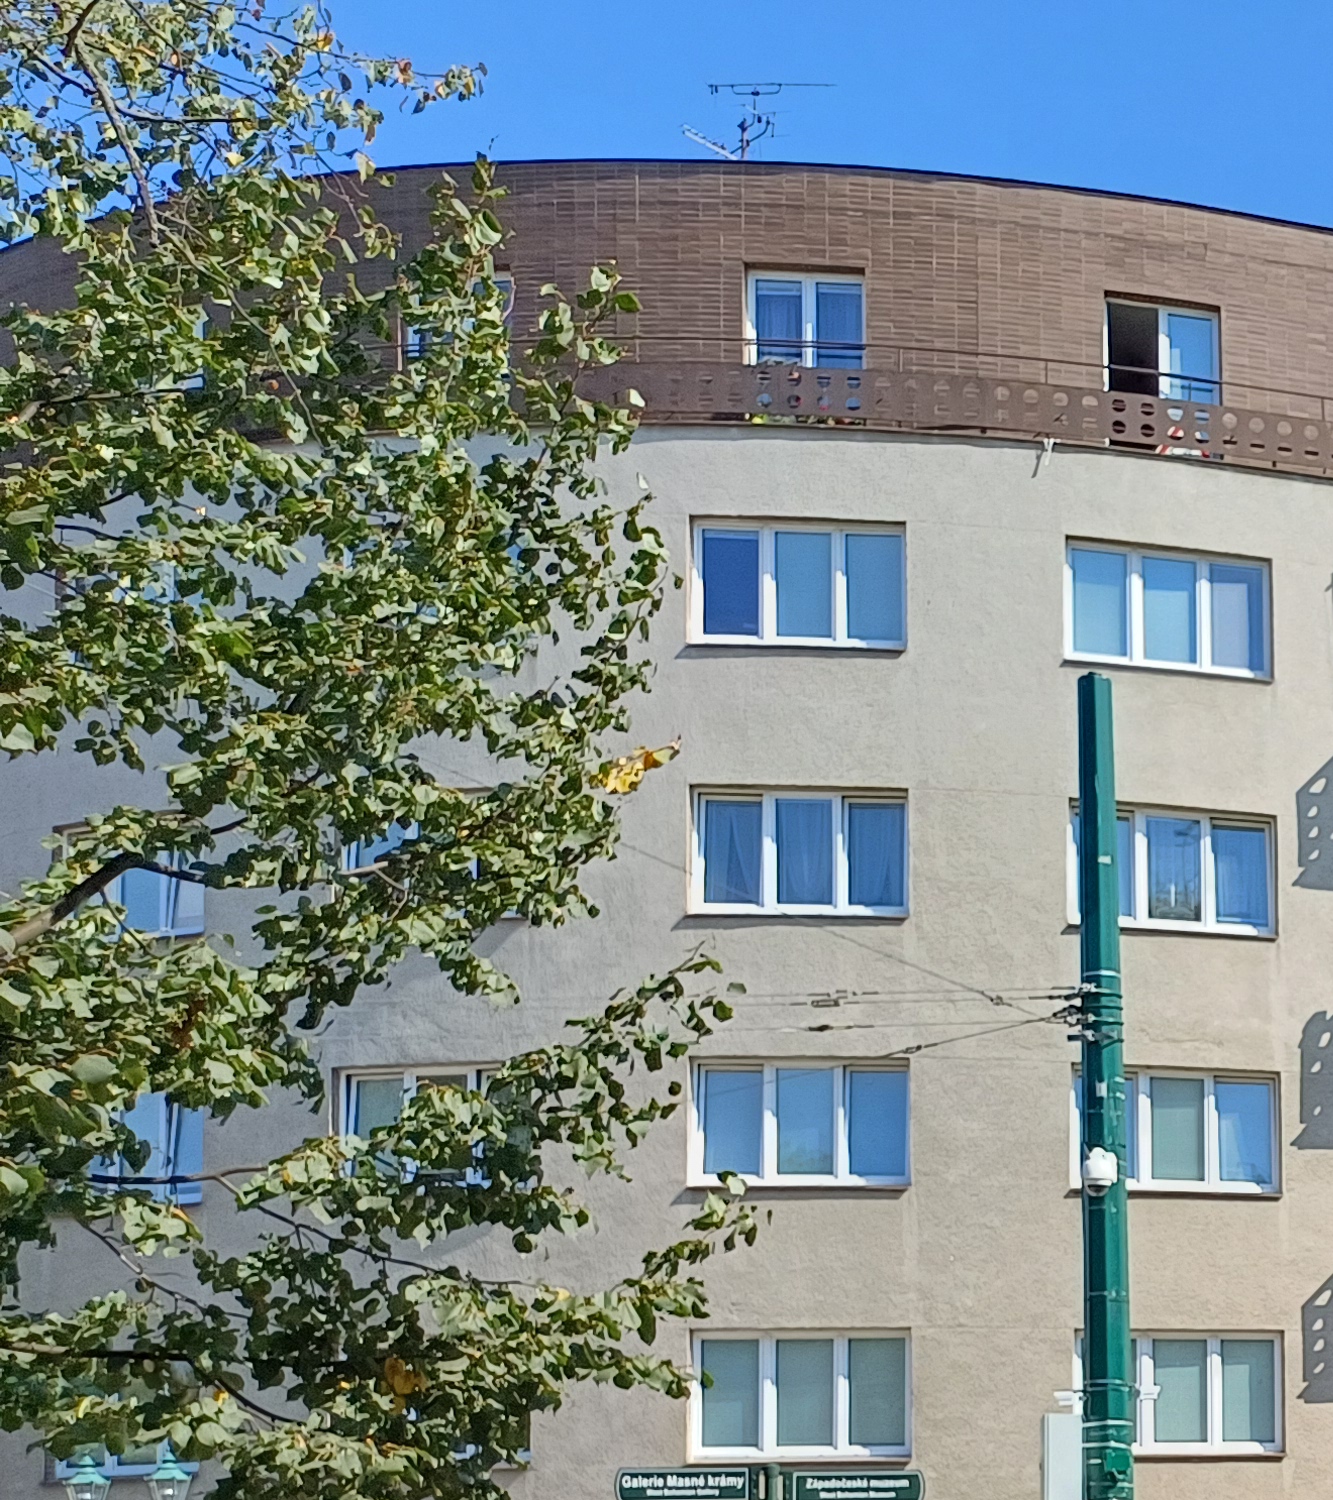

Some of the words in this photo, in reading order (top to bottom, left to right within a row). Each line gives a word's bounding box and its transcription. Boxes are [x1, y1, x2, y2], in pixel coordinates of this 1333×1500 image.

[621, 1474, 664, 1489] Galerie
[666, 1475, 705, 1487] Masné
[707, 1474, 745, 1490] krámy
